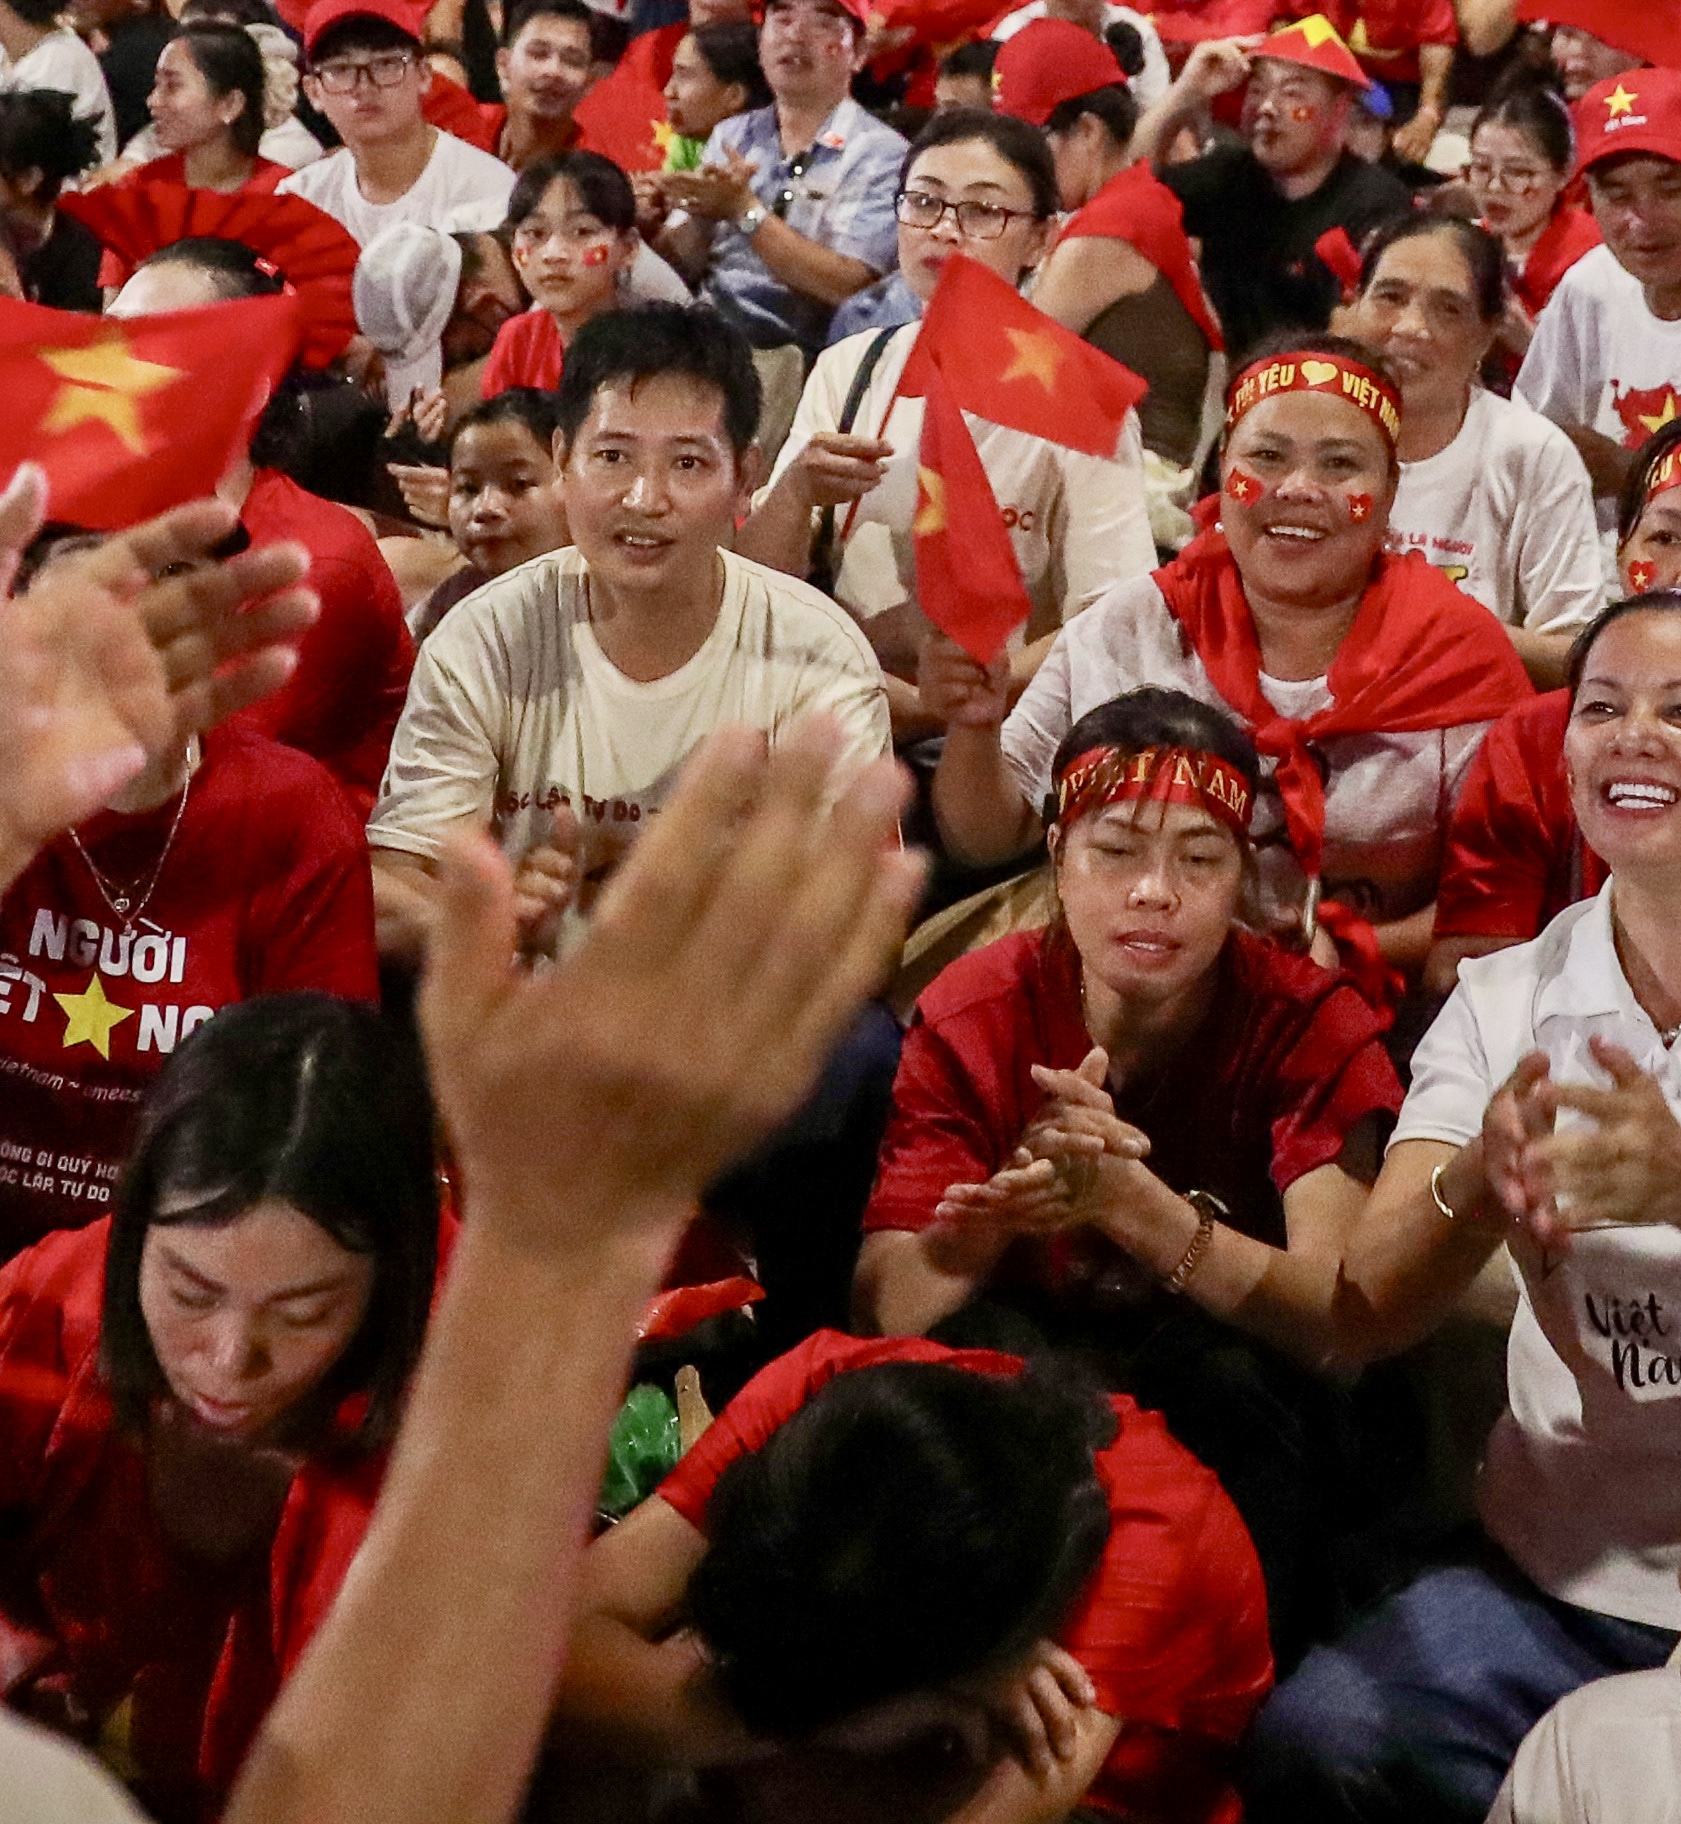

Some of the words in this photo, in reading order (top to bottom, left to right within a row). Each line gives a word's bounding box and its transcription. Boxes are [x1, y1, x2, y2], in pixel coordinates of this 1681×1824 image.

[1258, 362, 1295, 394] YÊU
[1342, 371, 1380, 408] VIỆT
[1379, 395, 1401, 442] NAM
[613, 799, 641, 822] DO
[29, 908, 186, 983] NGƯỜI
[87, 1184, 111, 1203] DO
[1585, 1291, 1672, 1347] Việt
